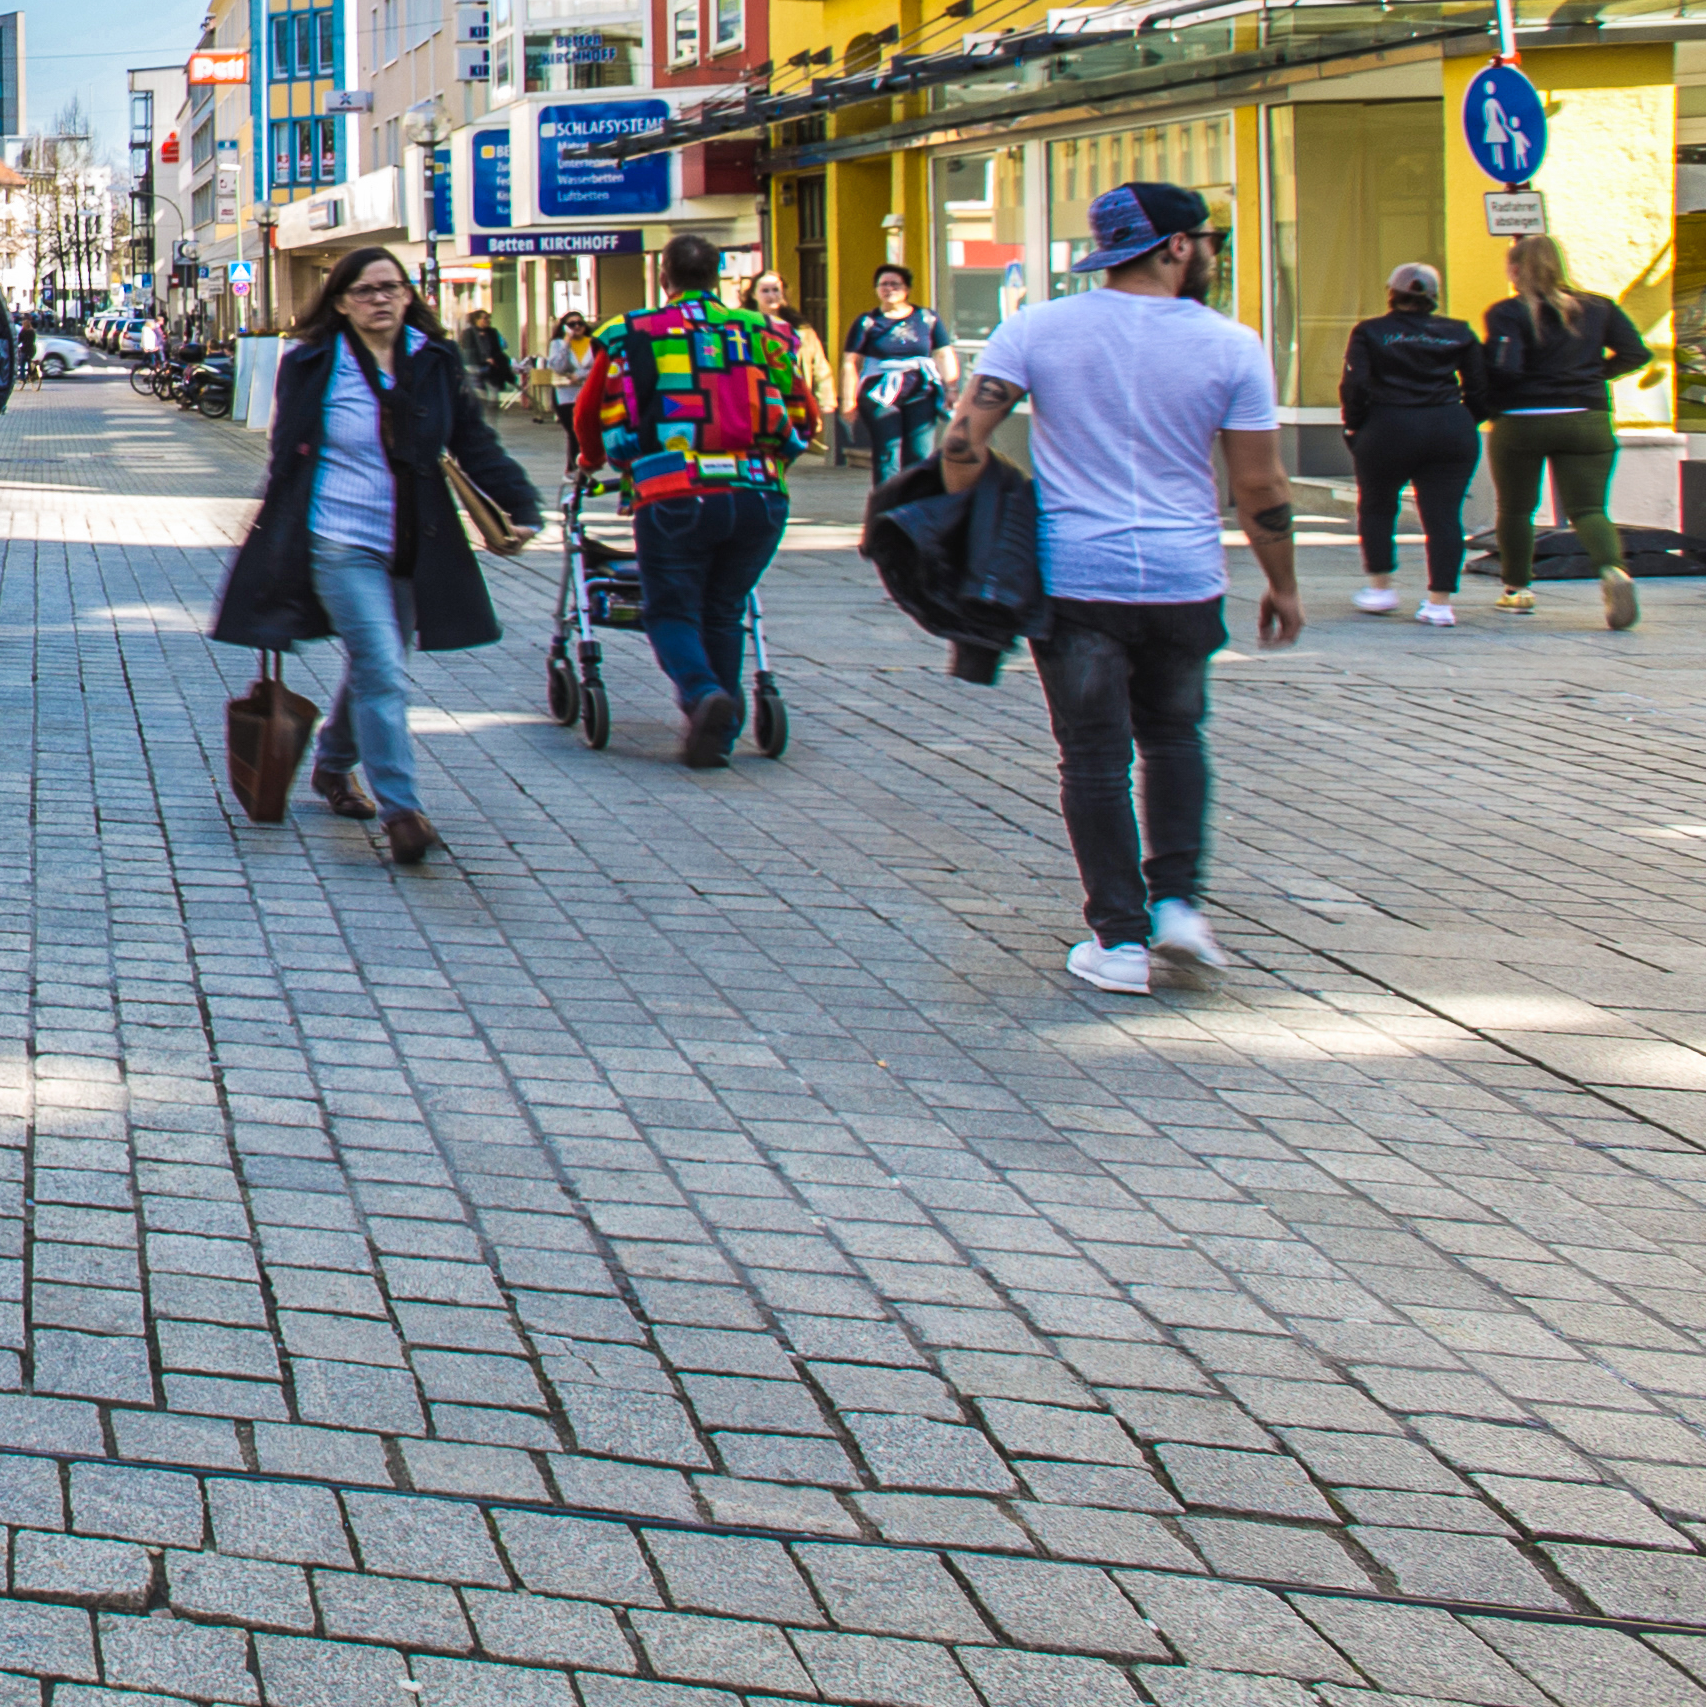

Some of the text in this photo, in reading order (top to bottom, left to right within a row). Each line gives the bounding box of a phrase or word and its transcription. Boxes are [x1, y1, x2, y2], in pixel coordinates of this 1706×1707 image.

[555, 34, 603, 49] Betten
[540, 47, 617, 66] KIRCHHOFF
[557, 174, 625, 185] Wasserbetten
[557, 190, 610, 203] Luftbetten
[1490, 201, 1539, 213] Radfahrer
[1494, 216, 1541, 229] absteigen
[488, 235, 620, 253] Betten KIRCHHOFF
